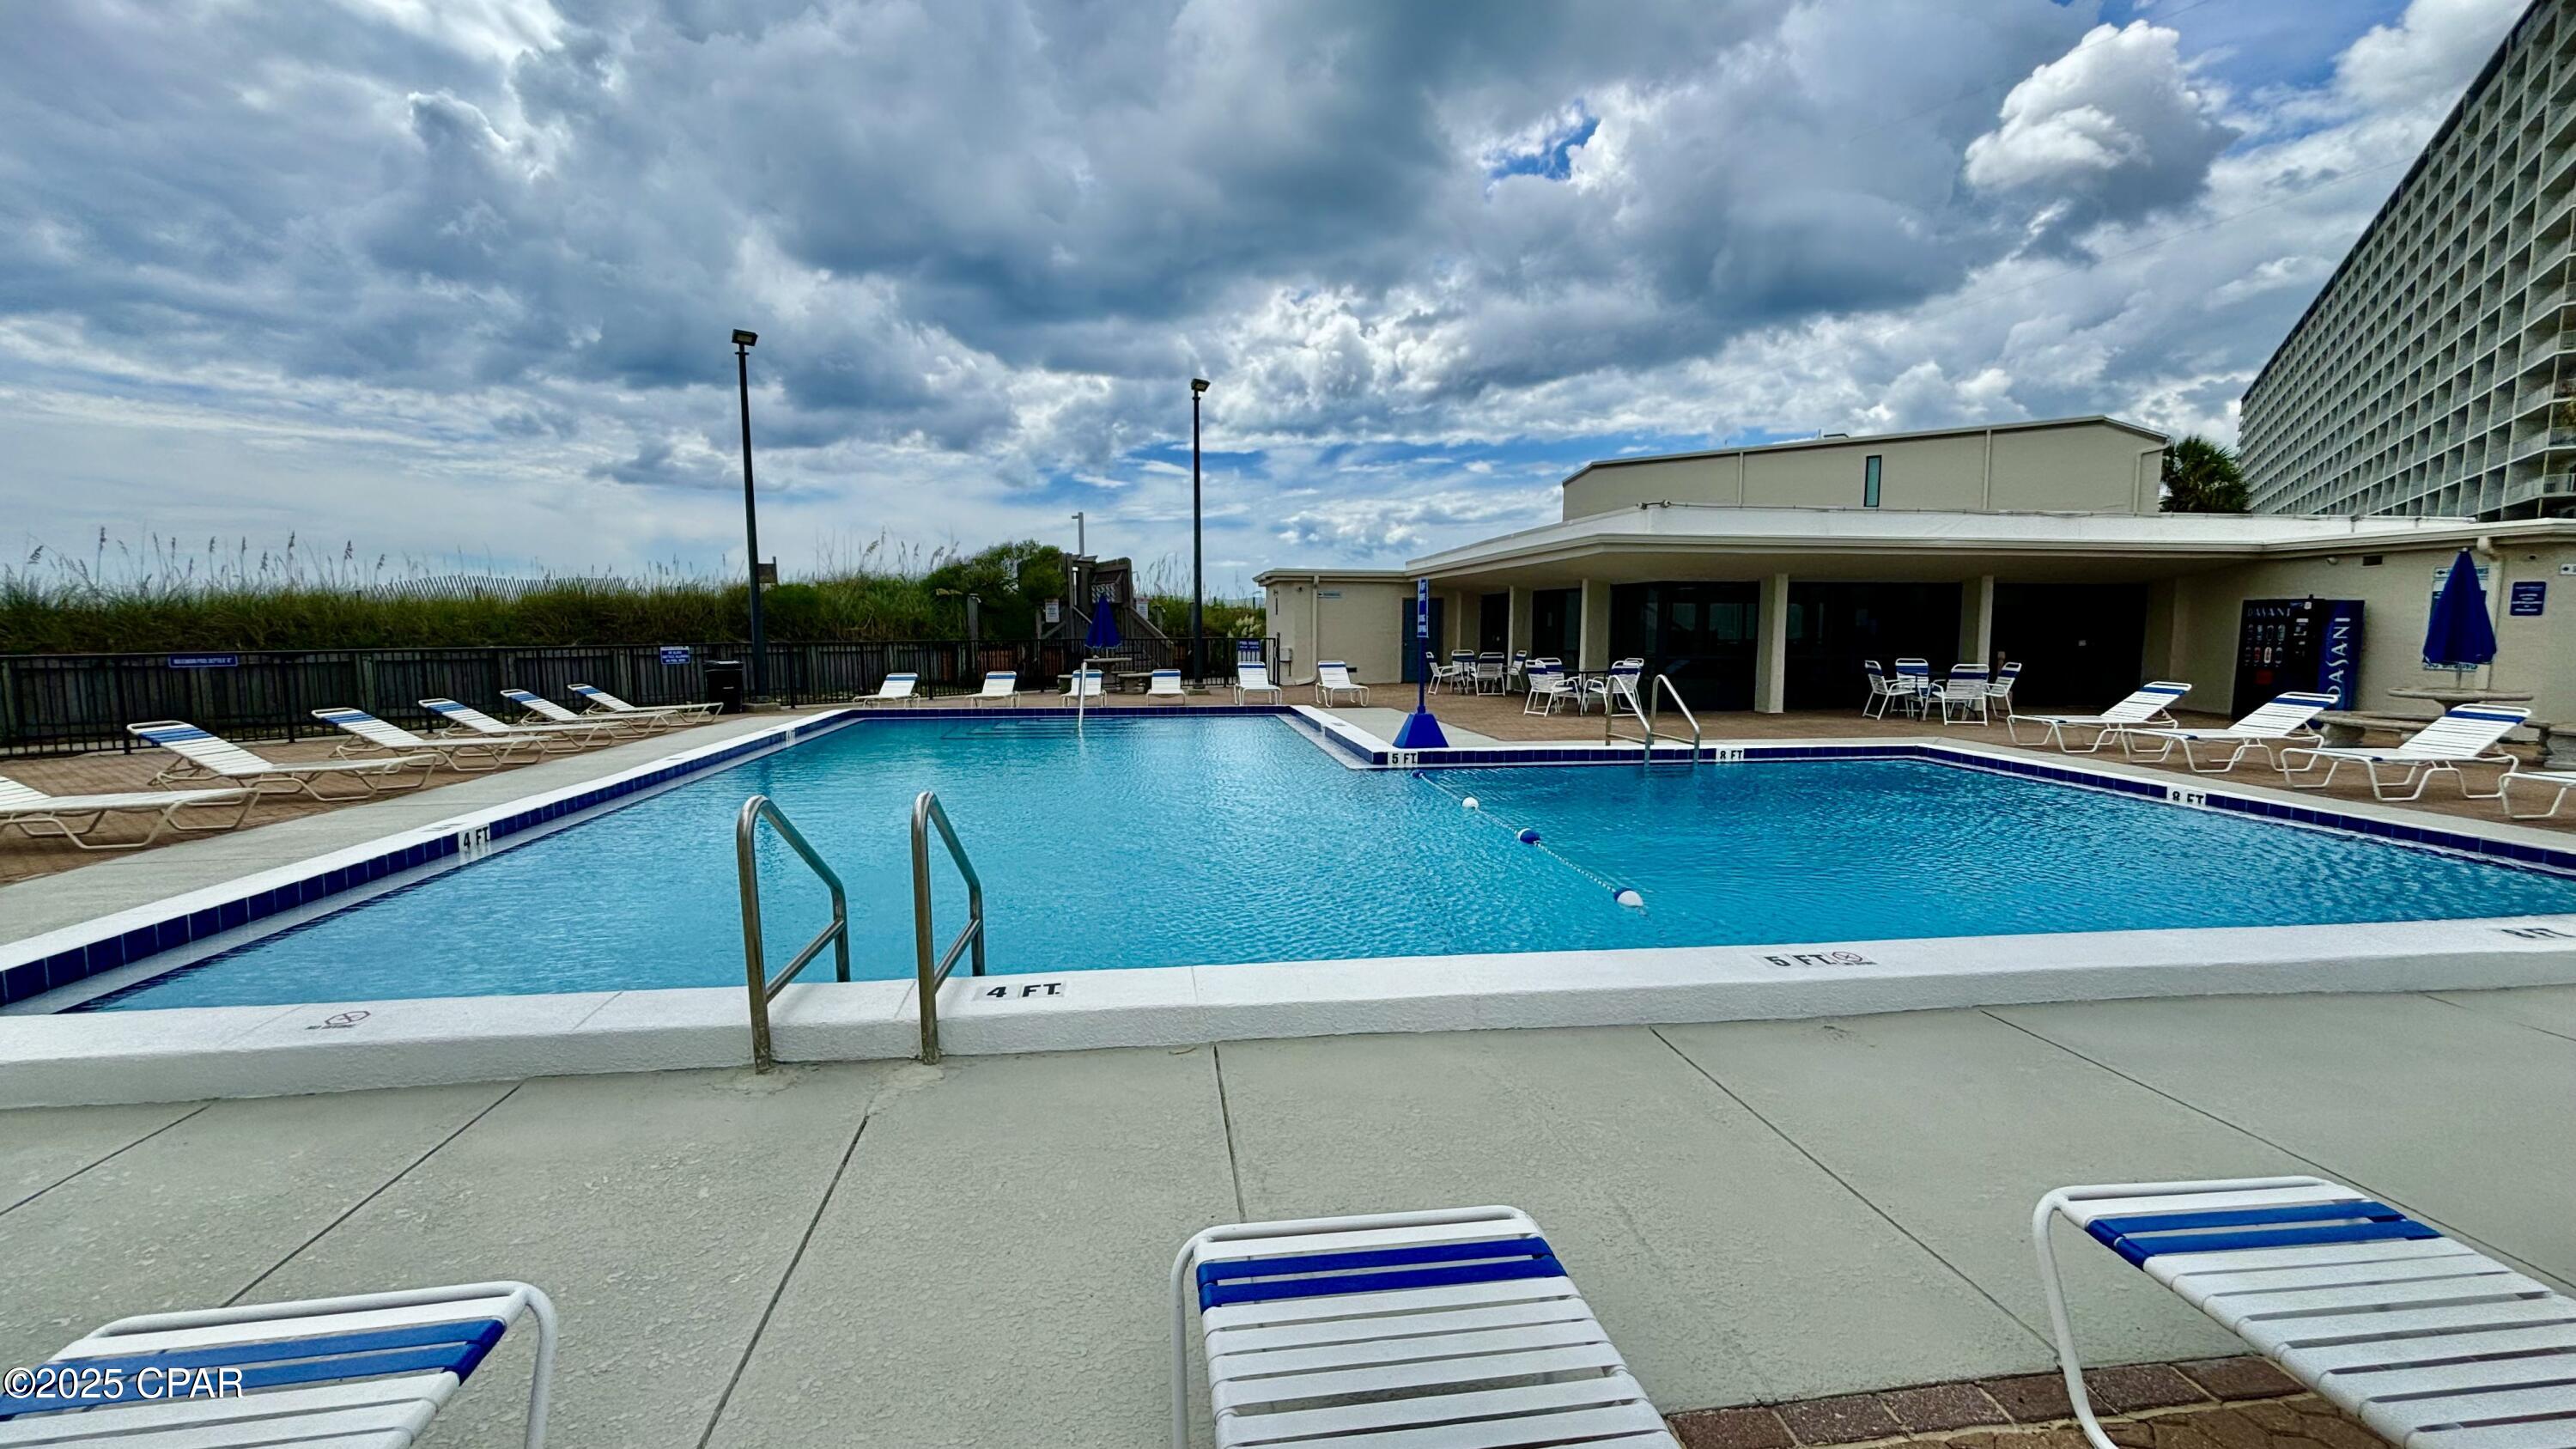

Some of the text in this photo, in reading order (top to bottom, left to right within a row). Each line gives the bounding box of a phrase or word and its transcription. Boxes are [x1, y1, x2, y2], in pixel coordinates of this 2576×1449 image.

[2325, 617, 2351, 697] DASANI
[1391, 752, 1399, 764] 5
[464, 831, 471, 851] 4
[1763, 956, 1791, 967] 5
[986, 983, 1062, 998] 4 FT.
